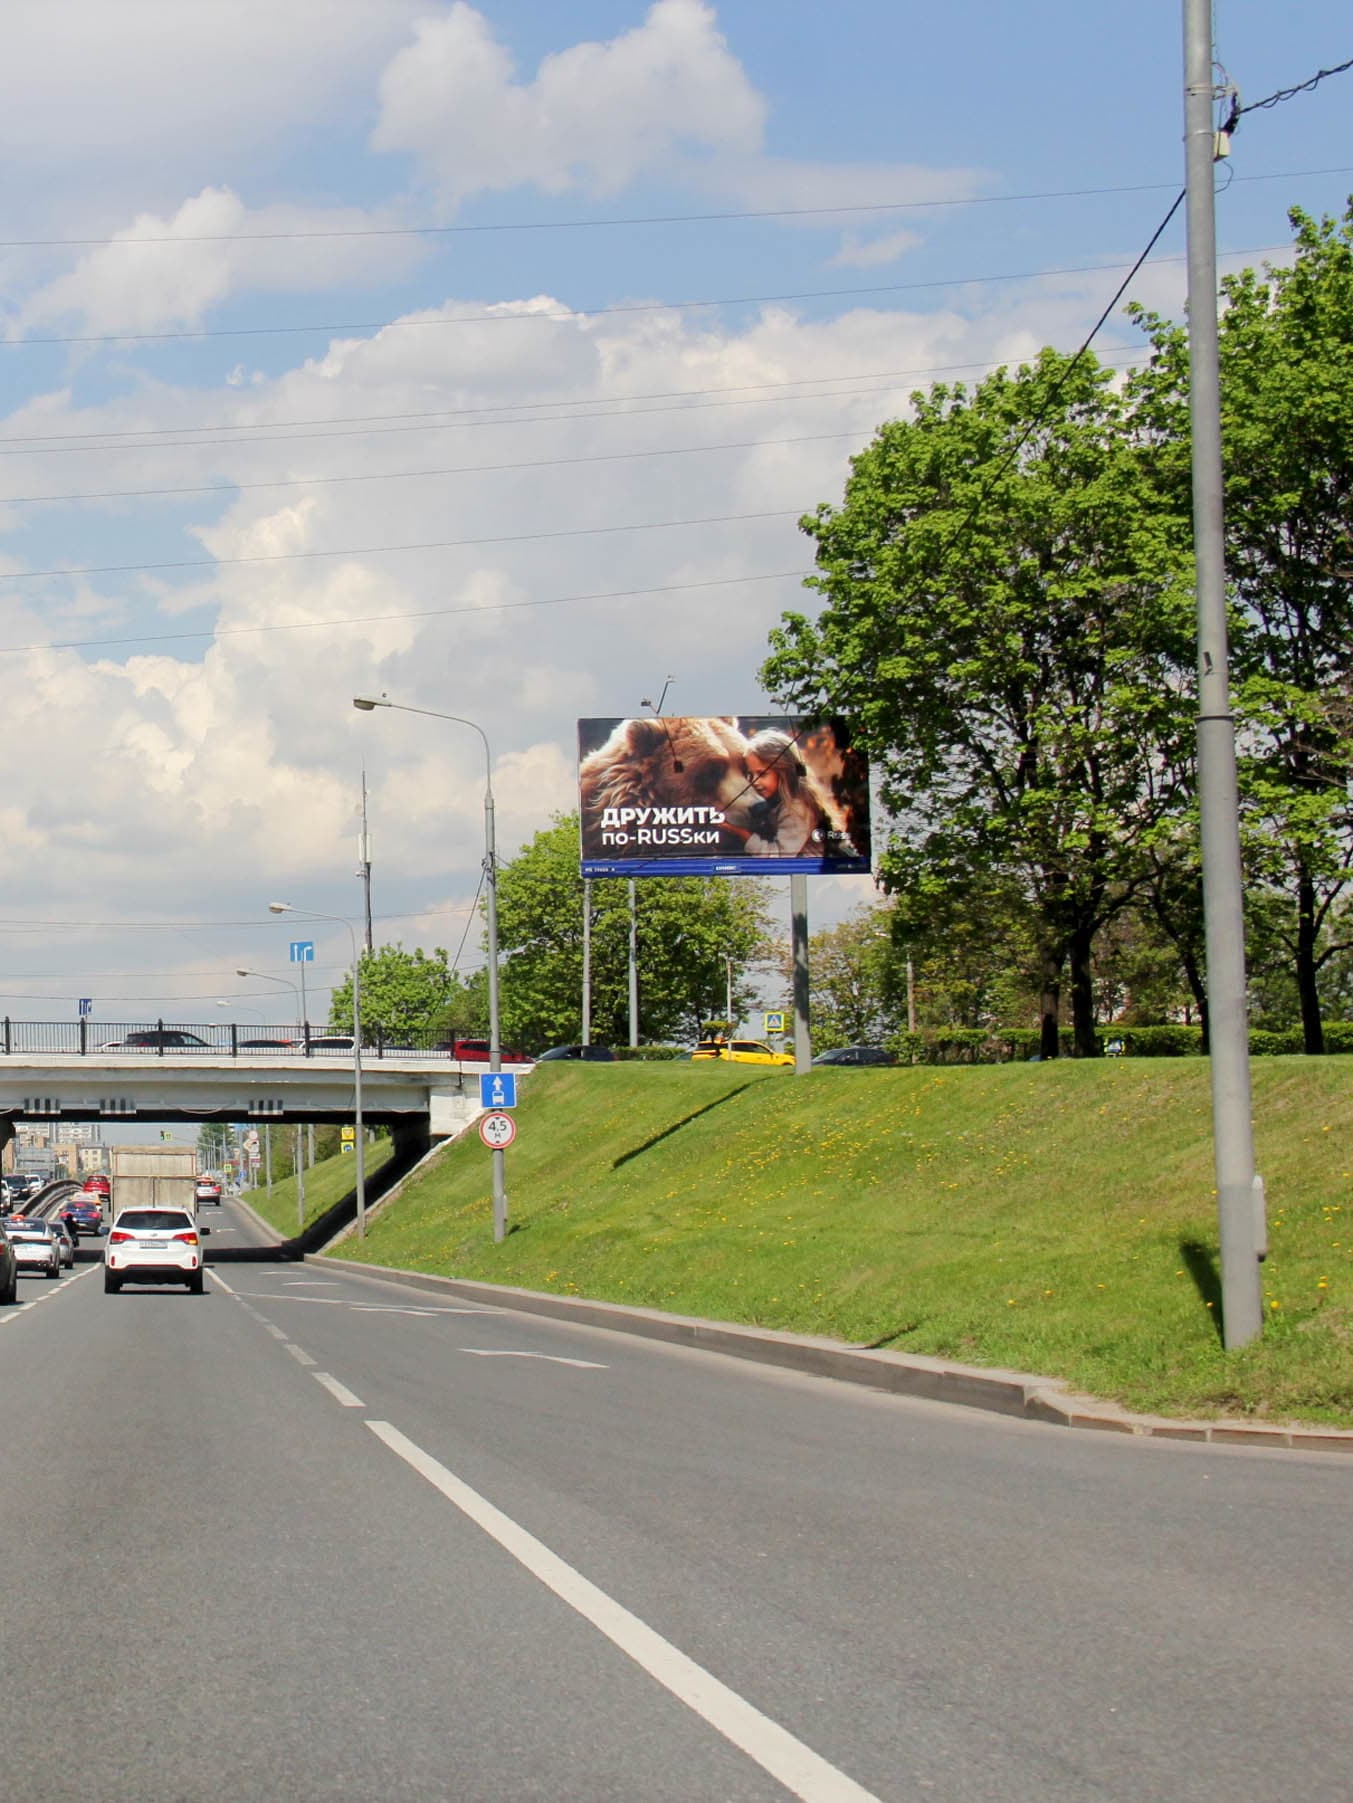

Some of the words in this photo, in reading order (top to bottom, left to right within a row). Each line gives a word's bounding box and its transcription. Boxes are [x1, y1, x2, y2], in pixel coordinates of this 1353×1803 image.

[601, 807, 725, 828] ДРУЖИТЬ
[602, 828, 720, 845] по-RUSSки
[488, 1120, 507, 1132] 4,5
